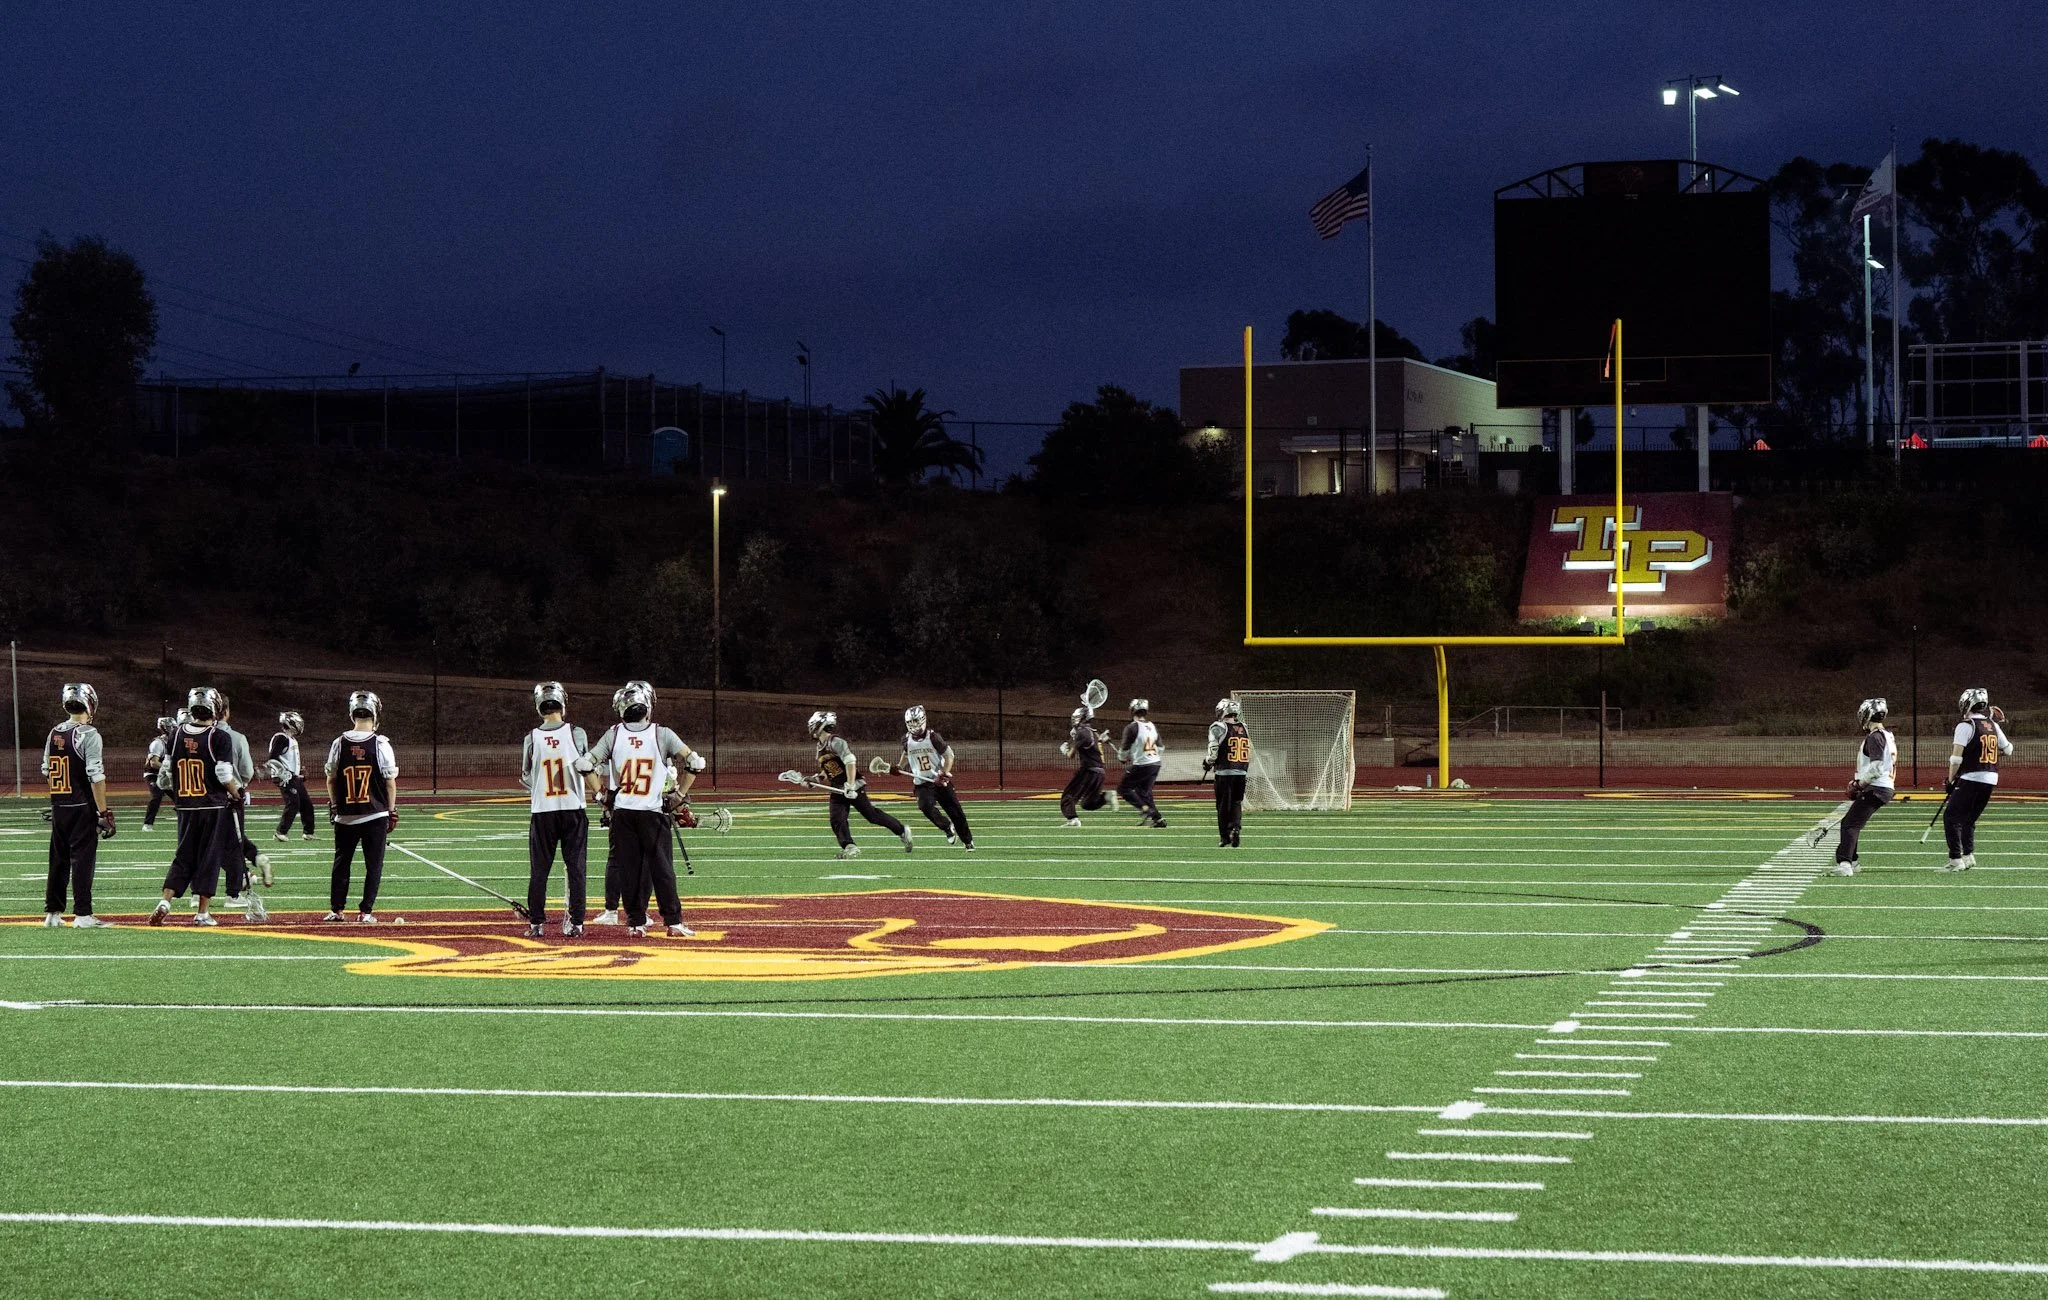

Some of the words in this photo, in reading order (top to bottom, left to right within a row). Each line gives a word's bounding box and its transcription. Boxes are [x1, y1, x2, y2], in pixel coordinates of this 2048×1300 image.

[1550, 504, 1713, 592] TP
[543, 736, 560, 749] TP
[628, 736, 643, 749] TP
[1227, 736, 1250, 763] 36
[1979, 734, 1998, 765] 19
[49, 755, 73, 795] 21
[177, 758, 208, 798] 10
[543, 757, 569, 797] 11
[618, 758, 654, 797] 45
[916, 755, 932, 772] 12
[343, 765, 373, 805] 17
